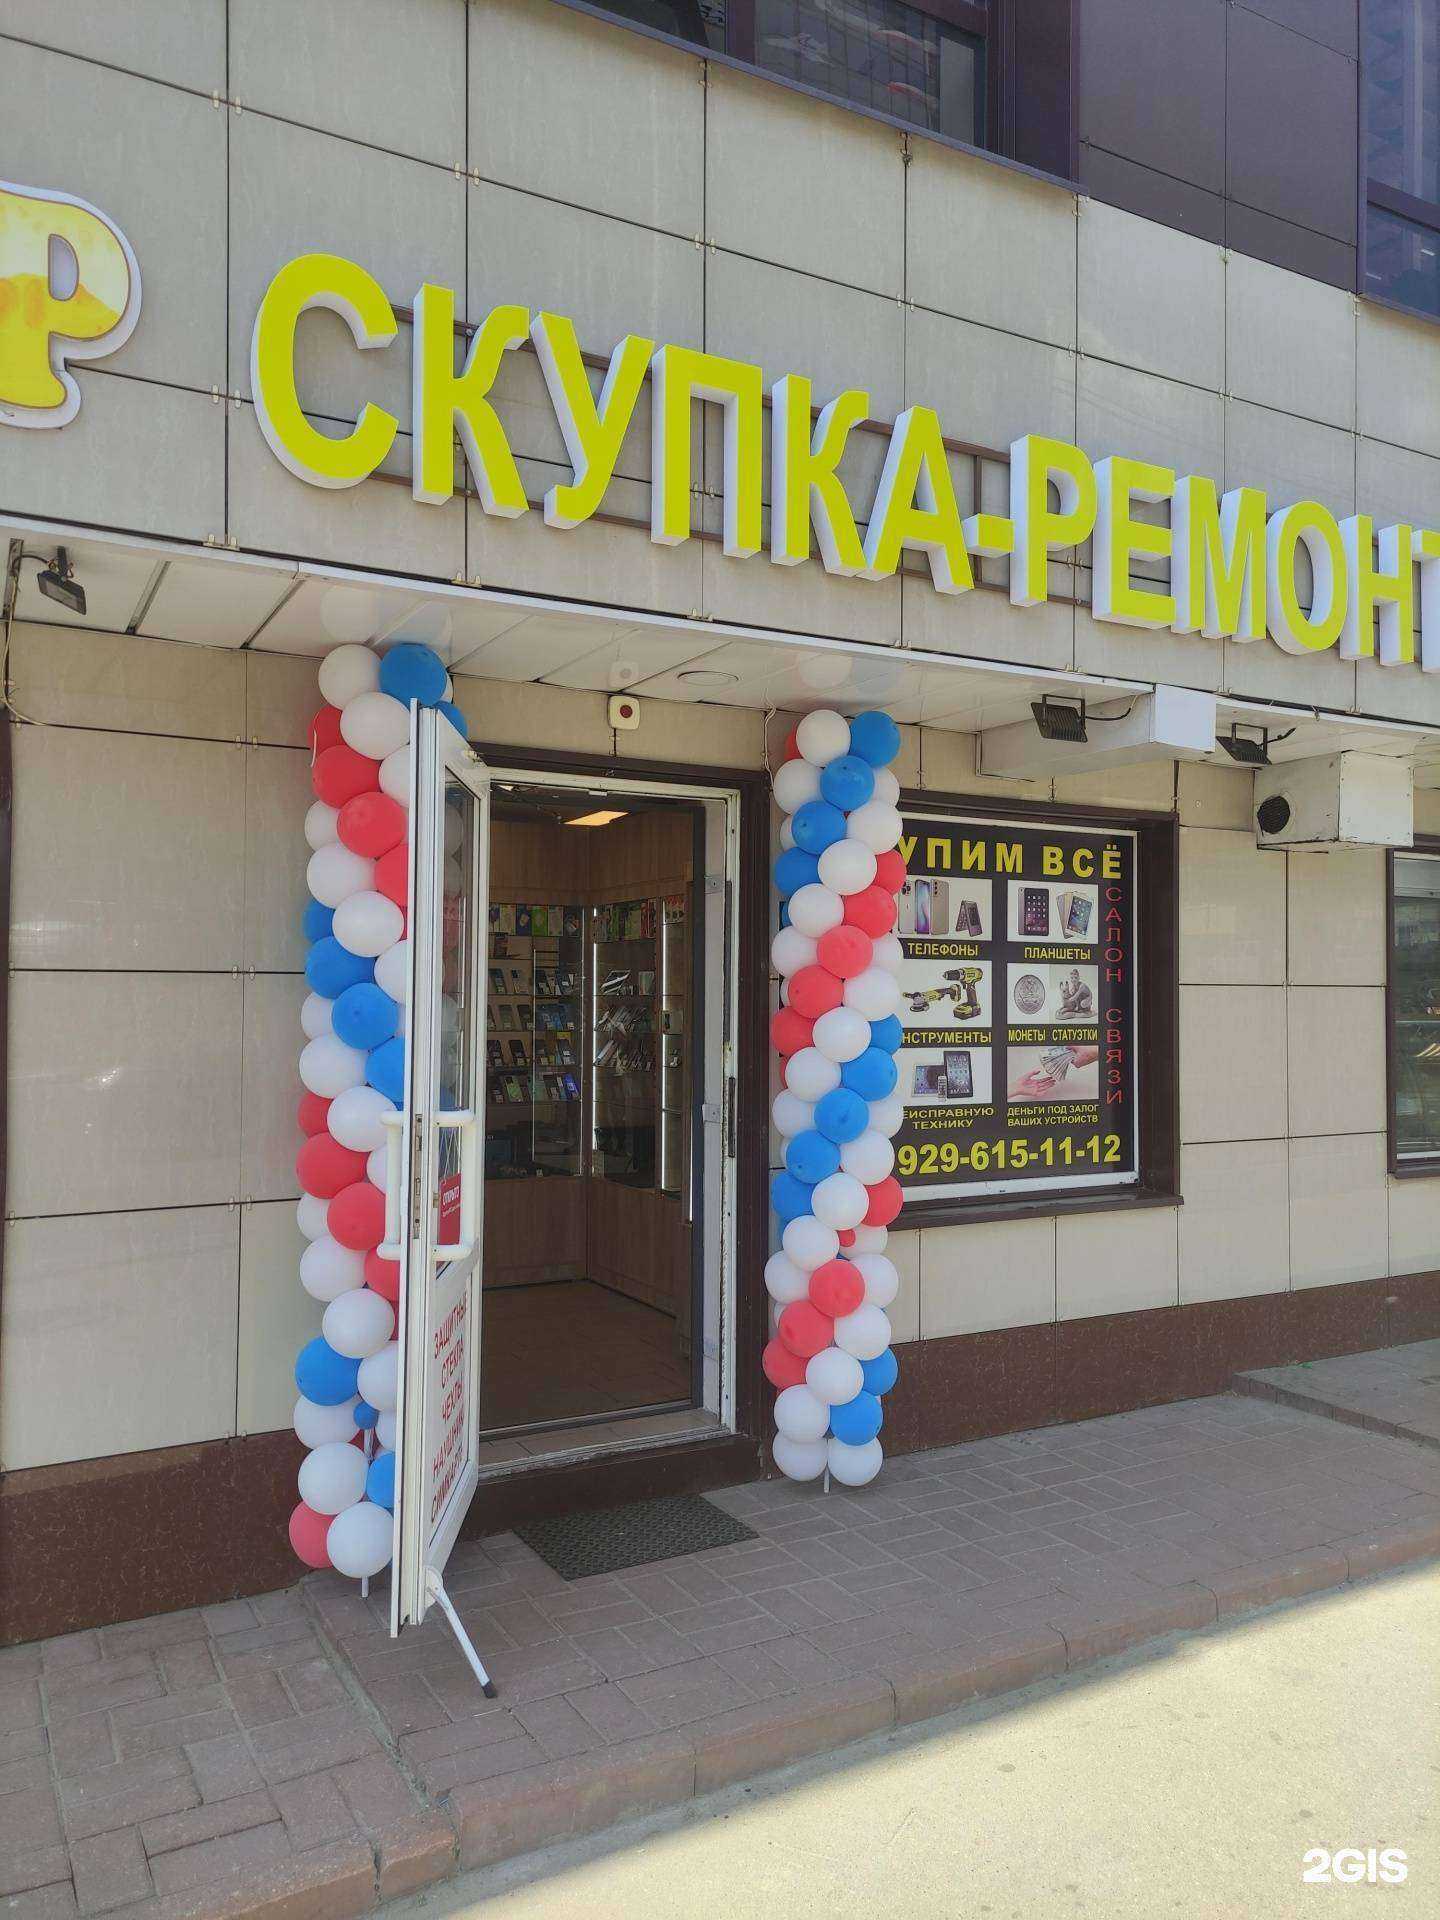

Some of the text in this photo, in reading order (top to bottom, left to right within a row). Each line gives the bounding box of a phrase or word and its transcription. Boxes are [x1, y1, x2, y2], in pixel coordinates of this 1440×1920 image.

[898, 837, 1122, 879] УПИМ ВСЁ
[907, 942, 979, 957] ТЕЛЕФОНЫ
[1024, 947, 1091, 960] ПЛАНШЕТЫ
[1104, 887, 1123, 1105] САЛОН СВЯЗИ
[902, 1031, 992, 1045] НСТРУМЕНТЫ
[1008, 1028, 1098, 1042] МОНЕТЫ СТАТУЭТКИ
[903, 1107, 994, 1120] ЕИСПРАВНУЮ
[1007, 1104, 1100, 1117] ДЕНЬГИ ПОД ЗАЛОГ
[912, 1119, 974, 1130] ТЕХНИКУ
[1007, 1114, 1099, 1127] ВАШИХ УСТРОЙСТВ
[897, 1134, 1121, 1176] 929-615-11-12
[434, 1290, 467, 1360] ЗАЩИТНЫ
